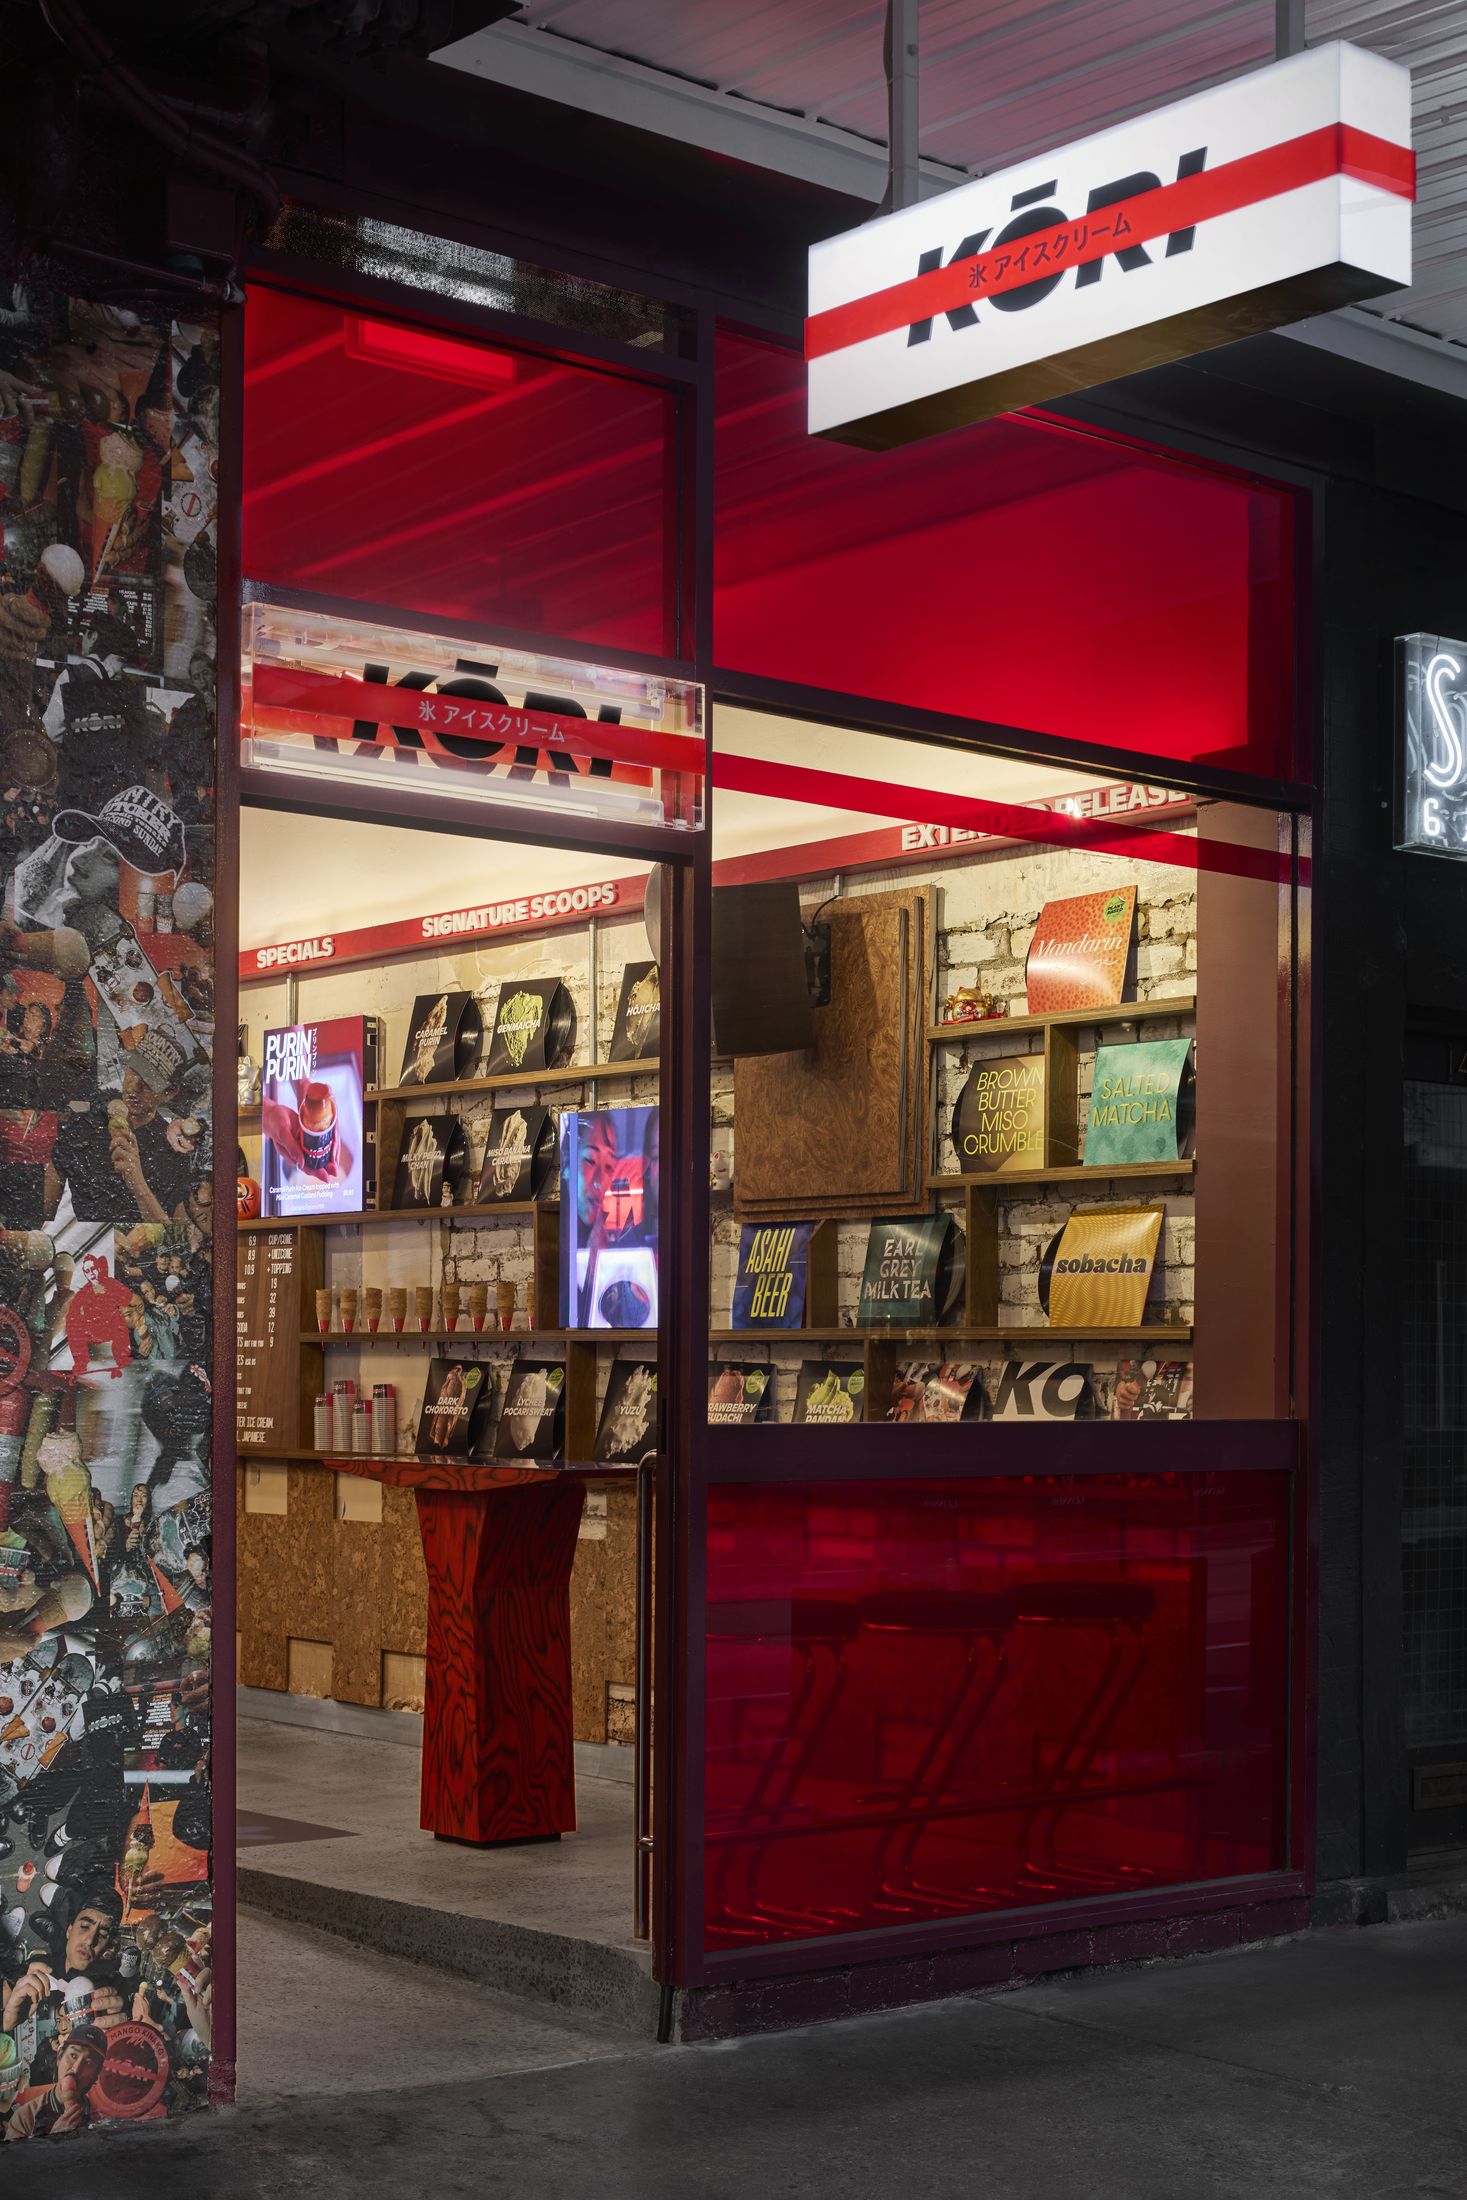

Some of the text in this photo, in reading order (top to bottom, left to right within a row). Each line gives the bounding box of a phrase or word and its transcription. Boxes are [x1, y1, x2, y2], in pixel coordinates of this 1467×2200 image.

[969, 212, 1132, 289] 氷 アイスクリーム
[418, 700, 565, 743] 氷 アイスクリーム
[422, 883, 616, 938] SIGNATURE SCOOPS
[257, 937, 334, 969] SPECIALS
[1033, 931, 1123, 958] Mandarin
[415, 1026, 448, 1039] CARAMEL
[497, 1019, 541, 1035] GENMAICHA
[265, 1029, 312, 1060] PURIN
[265, 1053, 312, 1084] PURIN
[977, 1066, 1044, 1091] BROWN
[1101, 1072, 1170, 1100] SALTED
[978, 1088, 1037, 1111] BUTTER
[981, 1109, 1029, 1132] MISO
[1092, 1099, 1172, 1128] MATCHA
[964, 1129, 1044, 1155] CRUMBLE
[745, 1228, 796, 1273] ASAHI
[883, 1238, 924, 1257] EARL
[879, 1259, 922, 1278] GREY
[1056, 1252, 1147, 1274] sobacha
[271, 1277, 278, 1289] 19
[864, 1279, 932, 1300] MILK TEA
[269, 1292, 277, 1304] 32
[750, 1272, 793, 1318] BEER
[268, 1307, 276, 1318] 39
[268, 1321, 275, 1333] 12
[269, 1336, 274, 1348] 9
[437, 1396, 459, 1406] DARK
[503, 1407, 554, 1417] POCARI SWEAT
[619, 1406, 641, 1416] YUZU
[806, 1404, 847, 1415] MATCHA
[110, 2027, 140, 2040] MANGO
